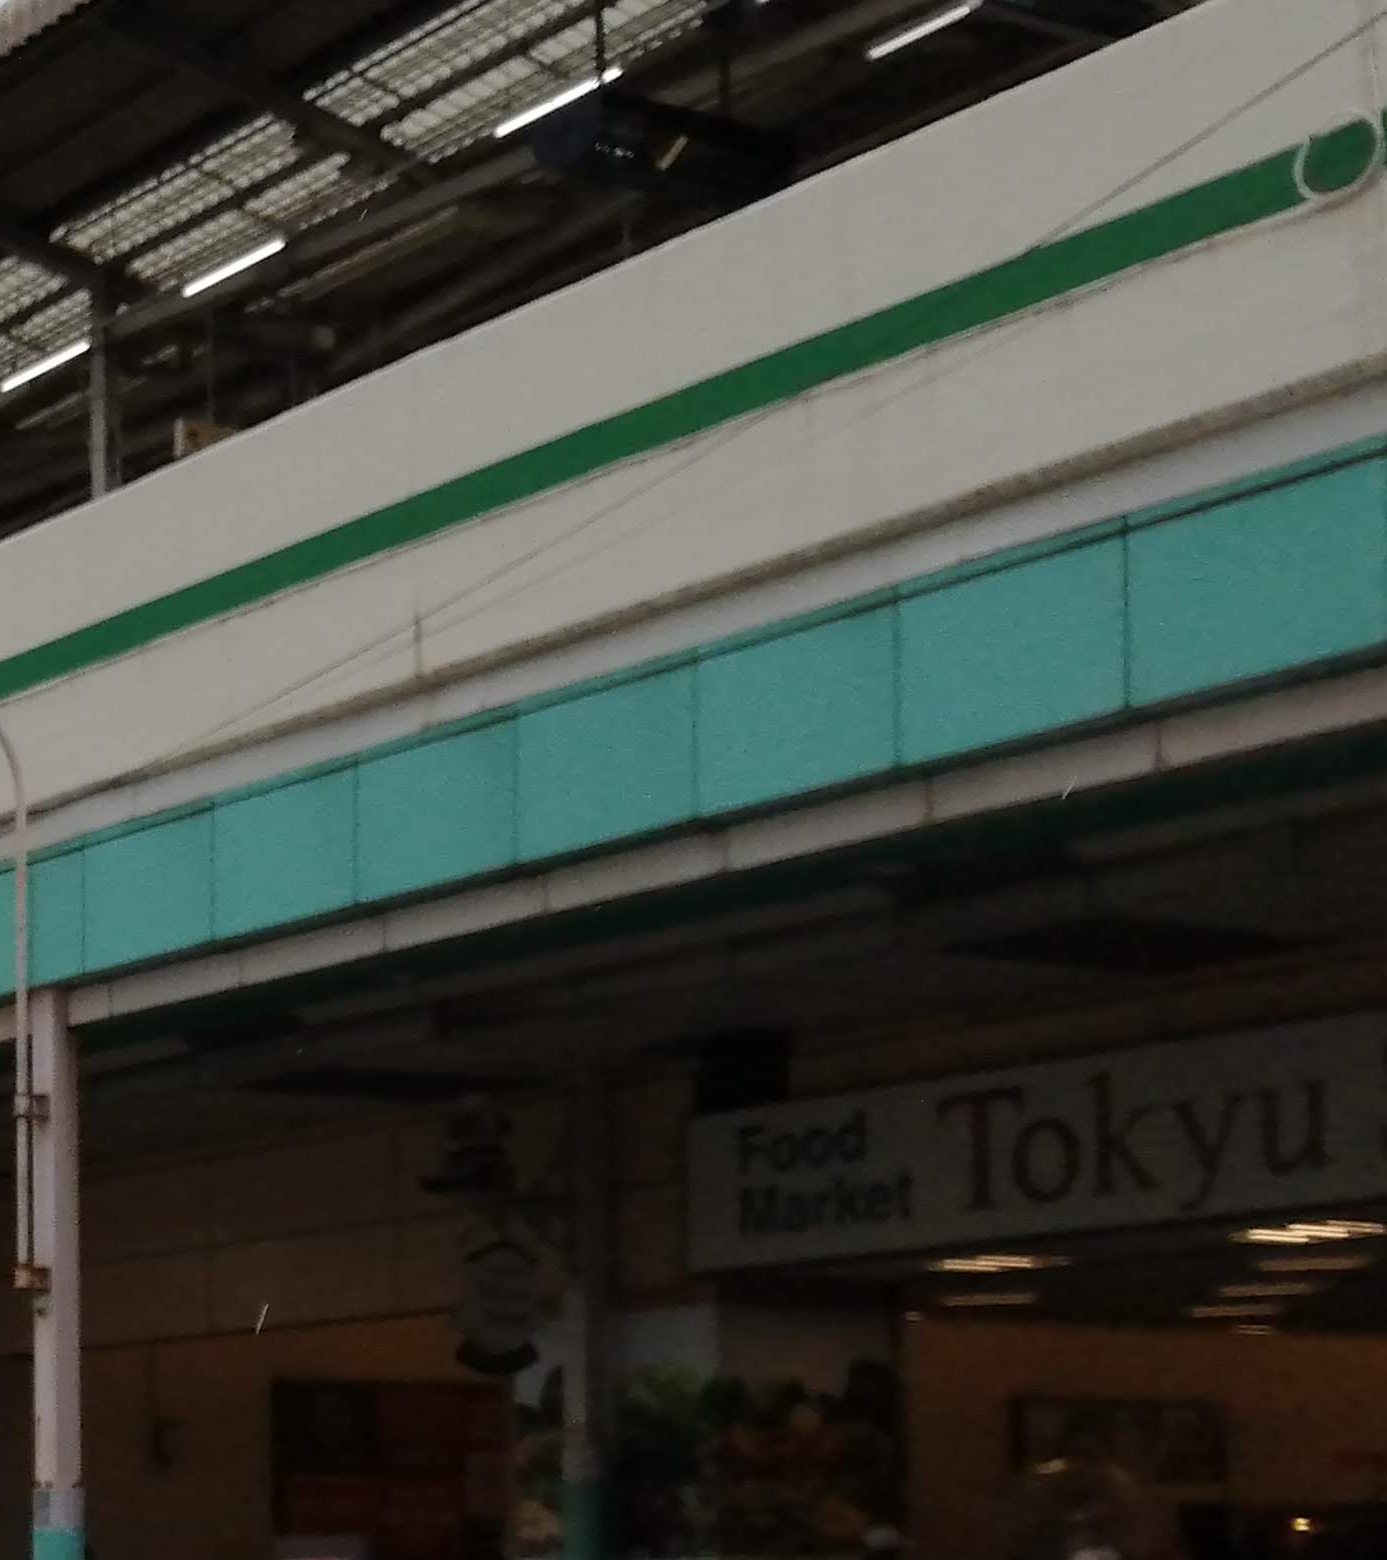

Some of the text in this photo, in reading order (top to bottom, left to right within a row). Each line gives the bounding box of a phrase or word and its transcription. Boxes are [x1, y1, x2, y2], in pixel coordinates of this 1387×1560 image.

[737, 1110, 868, 1173] Food
[936, 1073, 1334, 1213] Tokyu
[739, 1170, 915, 1234] Market
